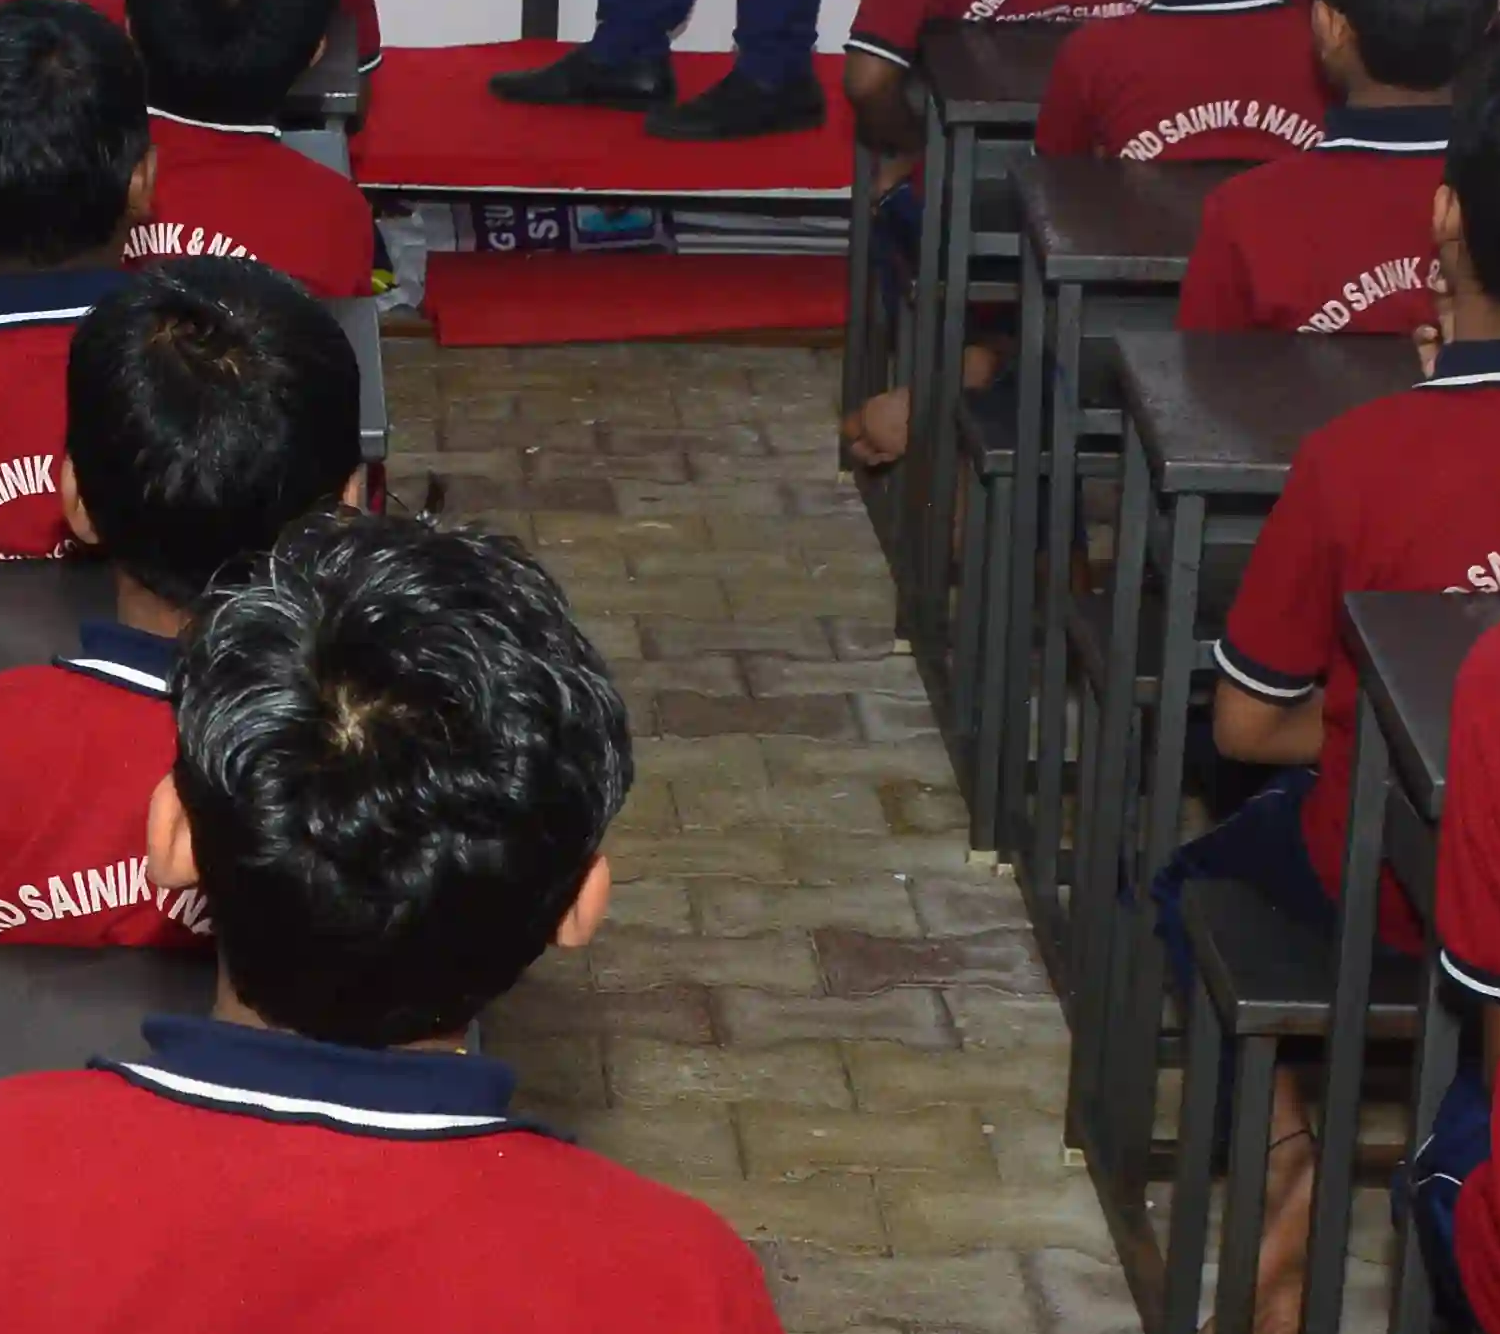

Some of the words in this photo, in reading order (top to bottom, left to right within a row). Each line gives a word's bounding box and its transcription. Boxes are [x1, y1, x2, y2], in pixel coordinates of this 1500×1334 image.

[1158, 100, 1240, 144] SAINIK
[1243, 101, 1260, 127] &
[186, 227, 204, 256] &
[1343, 257, 1422, 311] SAINIK
[18, 856, 151, 921] SAINIK
